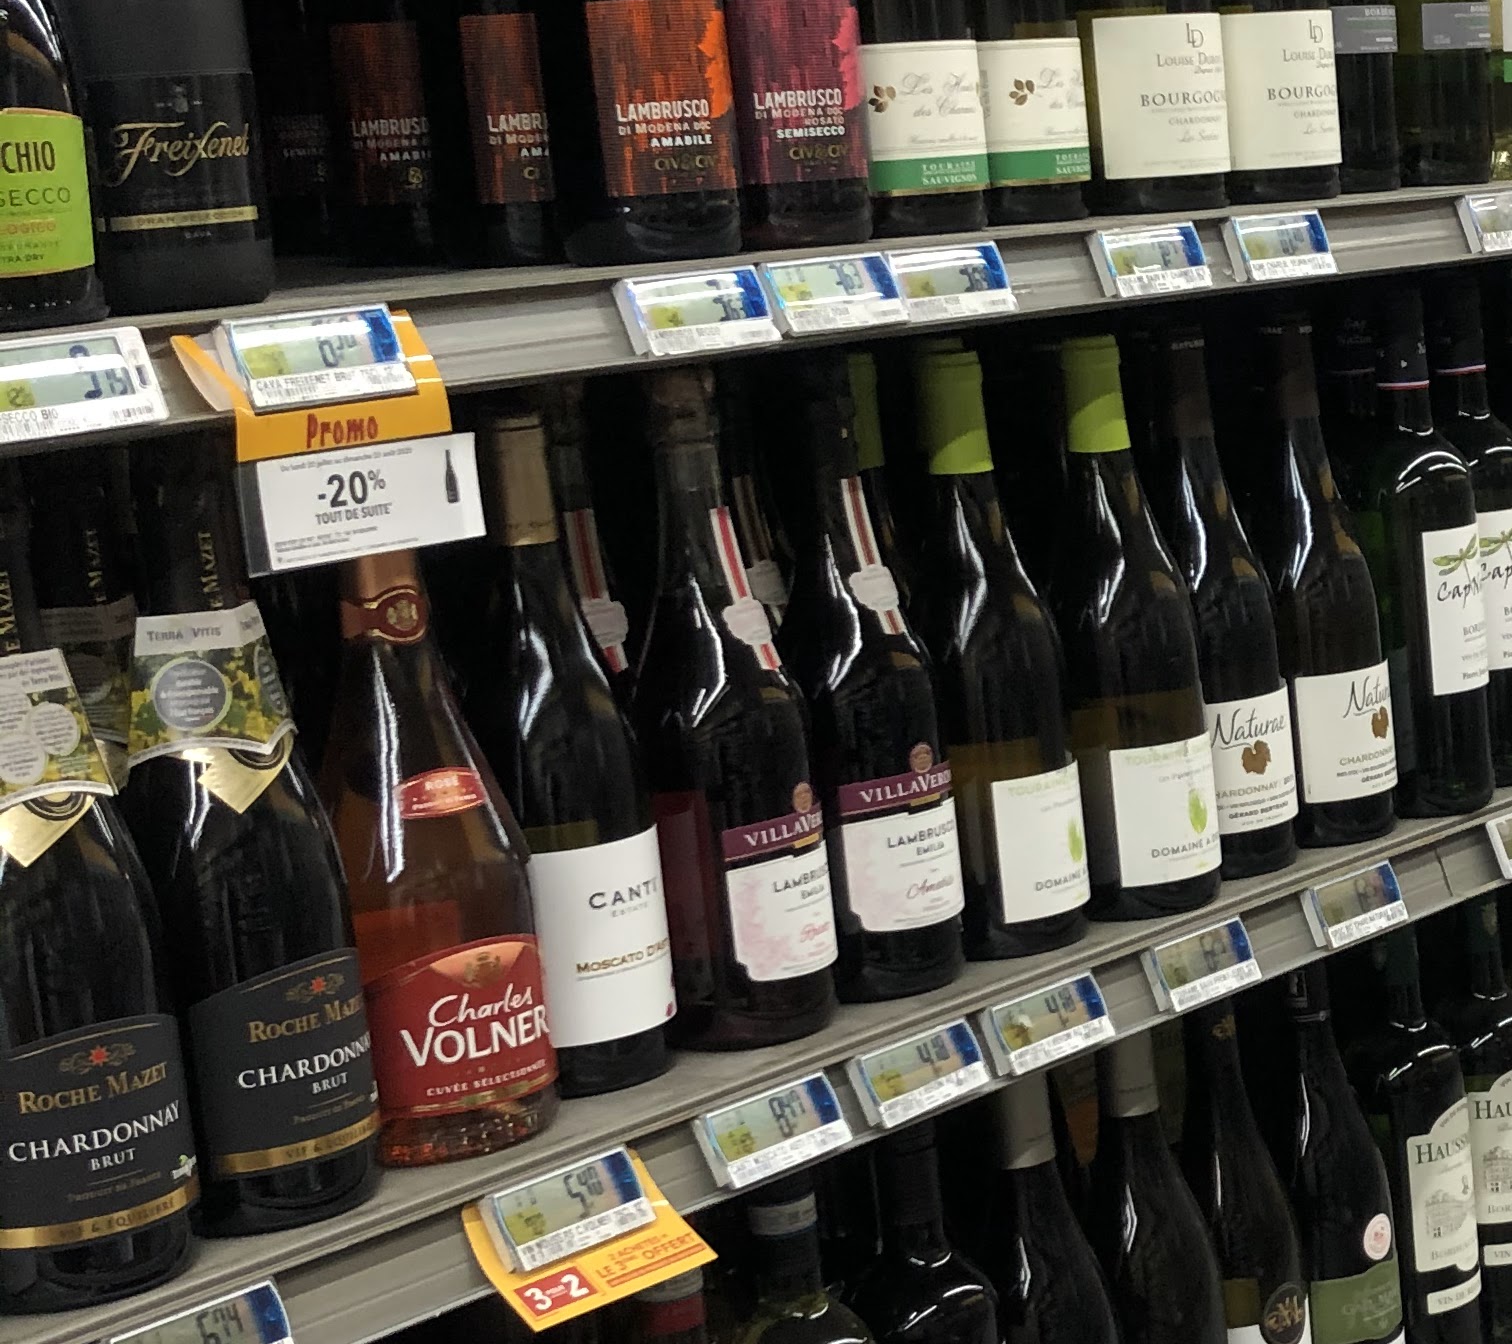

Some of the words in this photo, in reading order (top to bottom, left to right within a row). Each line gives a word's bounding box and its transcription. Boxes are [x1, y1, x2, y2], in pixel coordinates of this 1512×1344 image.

[616, 97, 710, 124] LAMBRUSCO
[753, 87, 843, 113] LAMBRUSCO
[771, 107, 824, 120] MODENA
[634, 120, 691, 136] MODENA
[650, 133, 713, 148] AMABILE
[776, 124, 846, 140] SEMISECCO
[106, 120, 250, 189] Freixenet
[921, 172, 978, 187] SAUVIGNON
[306, 412, 379, 450] Promo
[317, 469, 387, 508] -20%
[315, 510, 345, 526] TOUT
[347, 507, 360, 522] DE
[1151, 838, 1204, 859] DOMAINE
[587, 876, 659, 911] CANTI
[575, 948, 645, 976] MOSCATO
[428, 982, 534, 1030] Charles
[248, 1016, 320, 1045] ROCHE
[400, 1001, 552, 1069] VOLNER
[18, 1084, 102, 1116] ROCHE
[107, 1060, 169, 1098] MAZET
[312, 1071, 349, 1096] BRUT
[8, 1100, 182, 1164] CHARDONNAY
[90, 1147, 137, 1173] BRUT
[524, 1287, 553, 1311] 3
[560, 1273, 590, 1299] 2
